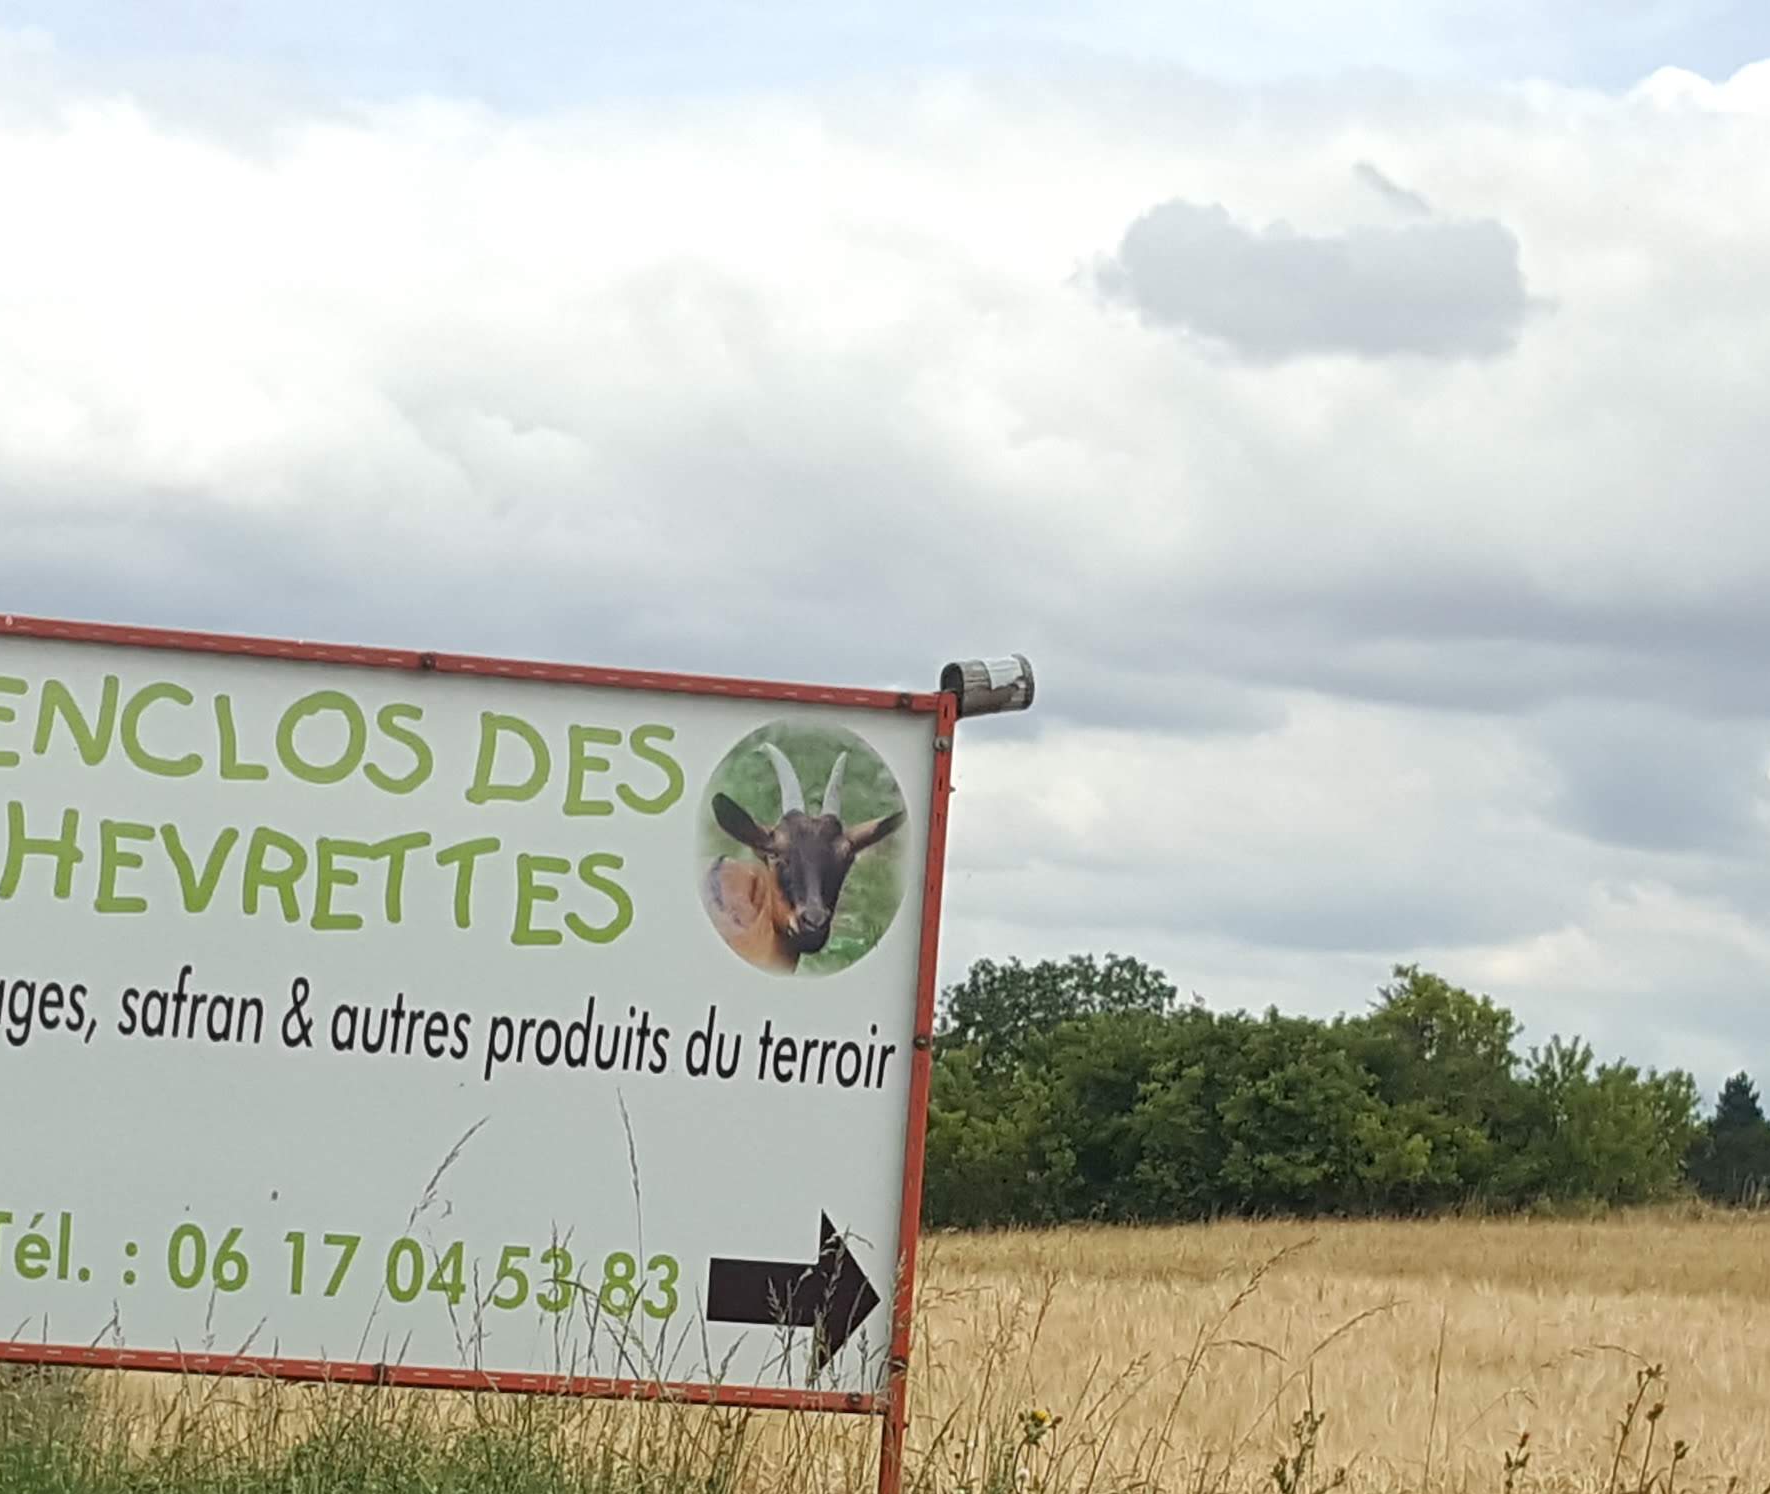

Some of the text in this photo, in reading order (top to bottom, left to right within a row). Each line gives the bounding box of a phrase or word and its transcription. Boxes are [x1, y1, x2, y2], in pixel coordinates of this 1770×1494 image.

[467, 713, 684, 817] DES
[117, 964, 264, 1044] safran
[281, 976, 314, 1048] &
[331, 994, 471, 1060] autres
[484, 996, 670, 1081] produits
[685, 1005, 742, 1079] du
[758, 1020, 896, 1089] terroir
[124, 1242, 140, 1285] :
[169, 1224, 249, 1292] 06
[287, 1232, 362, 1297] 17
[387, 1237, 466, 1306] 04
[490, 1247, 575, 1313] 53
[598, 1251, 680, 1321] 83
